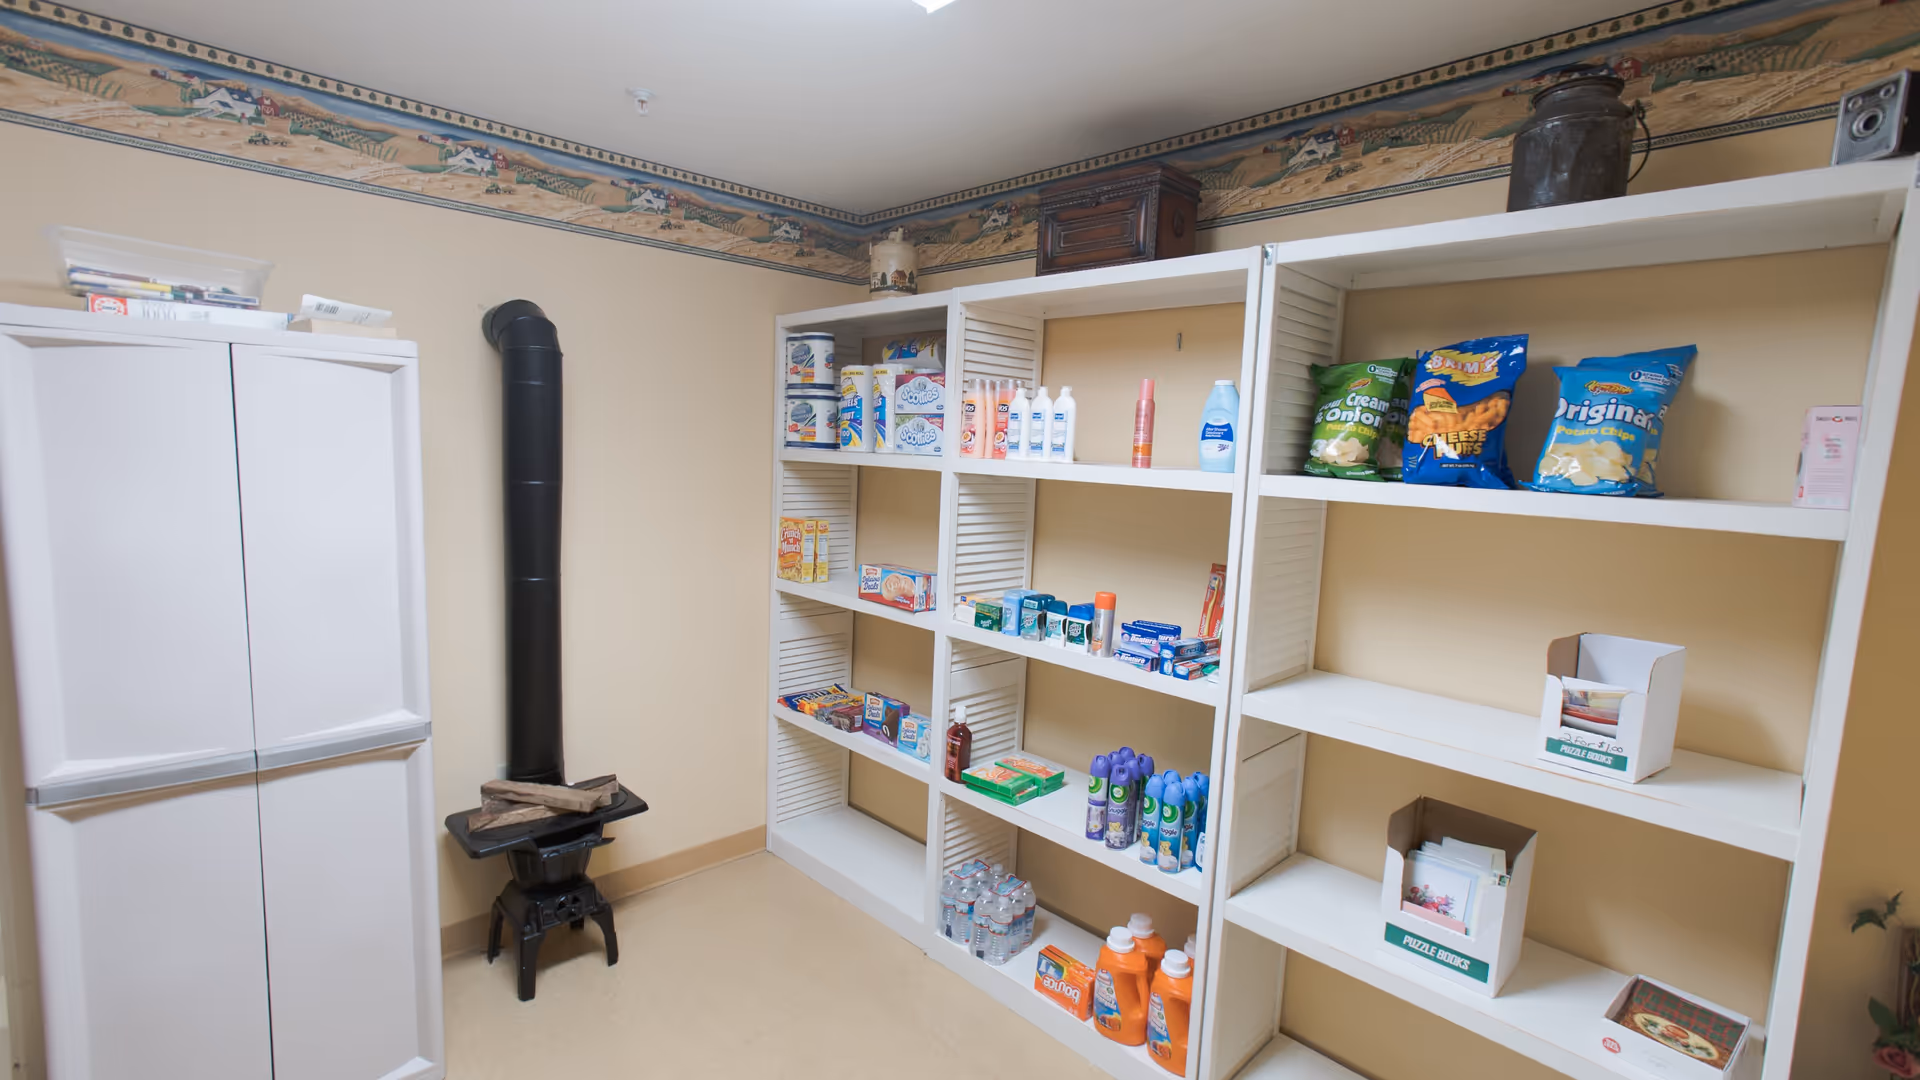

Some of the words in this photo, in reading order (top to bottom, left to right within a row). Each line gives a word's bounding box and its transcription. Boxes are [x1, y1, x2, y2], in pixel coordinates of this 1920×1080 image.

[1431, 355, 1495, 374] BRIM'S
[1346, 392, 1390, 412] Cream
[1325, 406, 1384, 428] Onion
[1358, 426, 1378, 439] Chip
[1422, 430, 1488, 448] CHEESE
[1556, 425, 1598, 436] Potato
[1600, 426, 1636, 442] Chips
[1559, 733, 1573, 744] 2
[1560, 744, 1588, 758] PUZZLE
[1587, 751, 1614, 765] BOOKS
[1403, 934, 1437, 957] PUZZLE
[1437, 948, 1471, 971] BOOKS
[1042, 975, 1081, 1006] bounce
